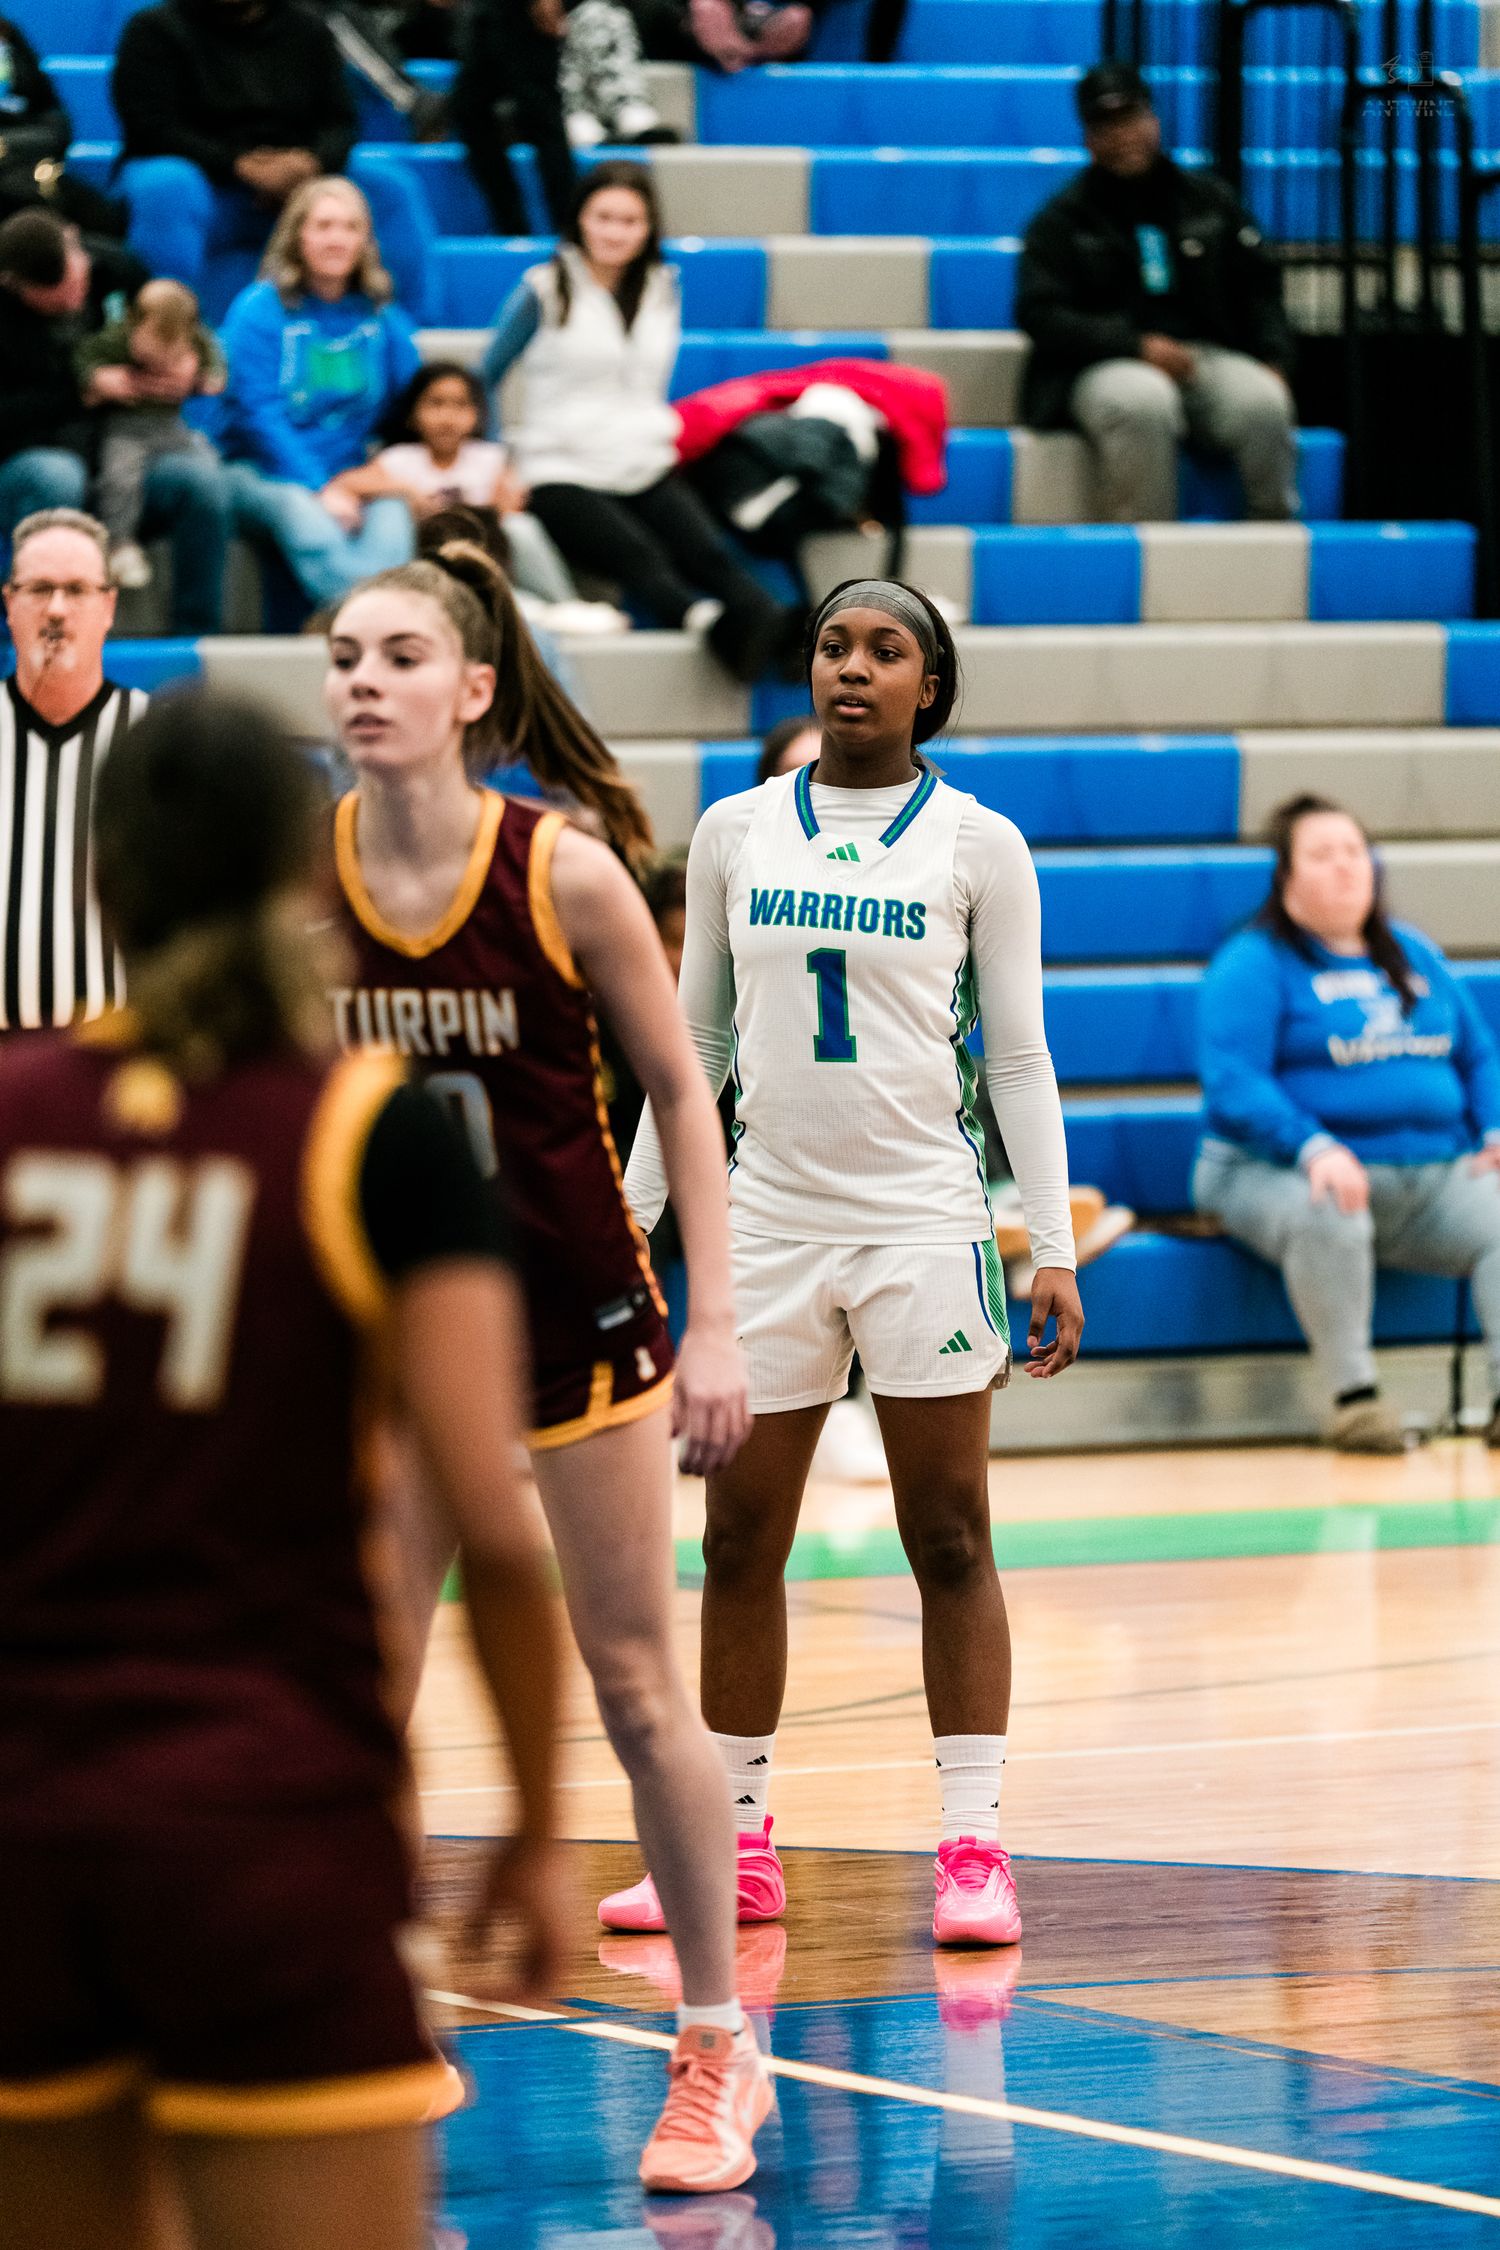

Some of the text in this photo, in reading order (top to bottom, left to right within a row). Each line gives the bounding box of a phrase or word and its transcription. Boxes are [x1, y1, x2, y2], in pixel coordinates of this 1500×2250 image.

[749, 887, 927, 940] WARRIORS
[330, 986, 520, 1056] TURPIN
[806, 947, 857, 1063] 1
[0, 1151, 256, 1408] 24
